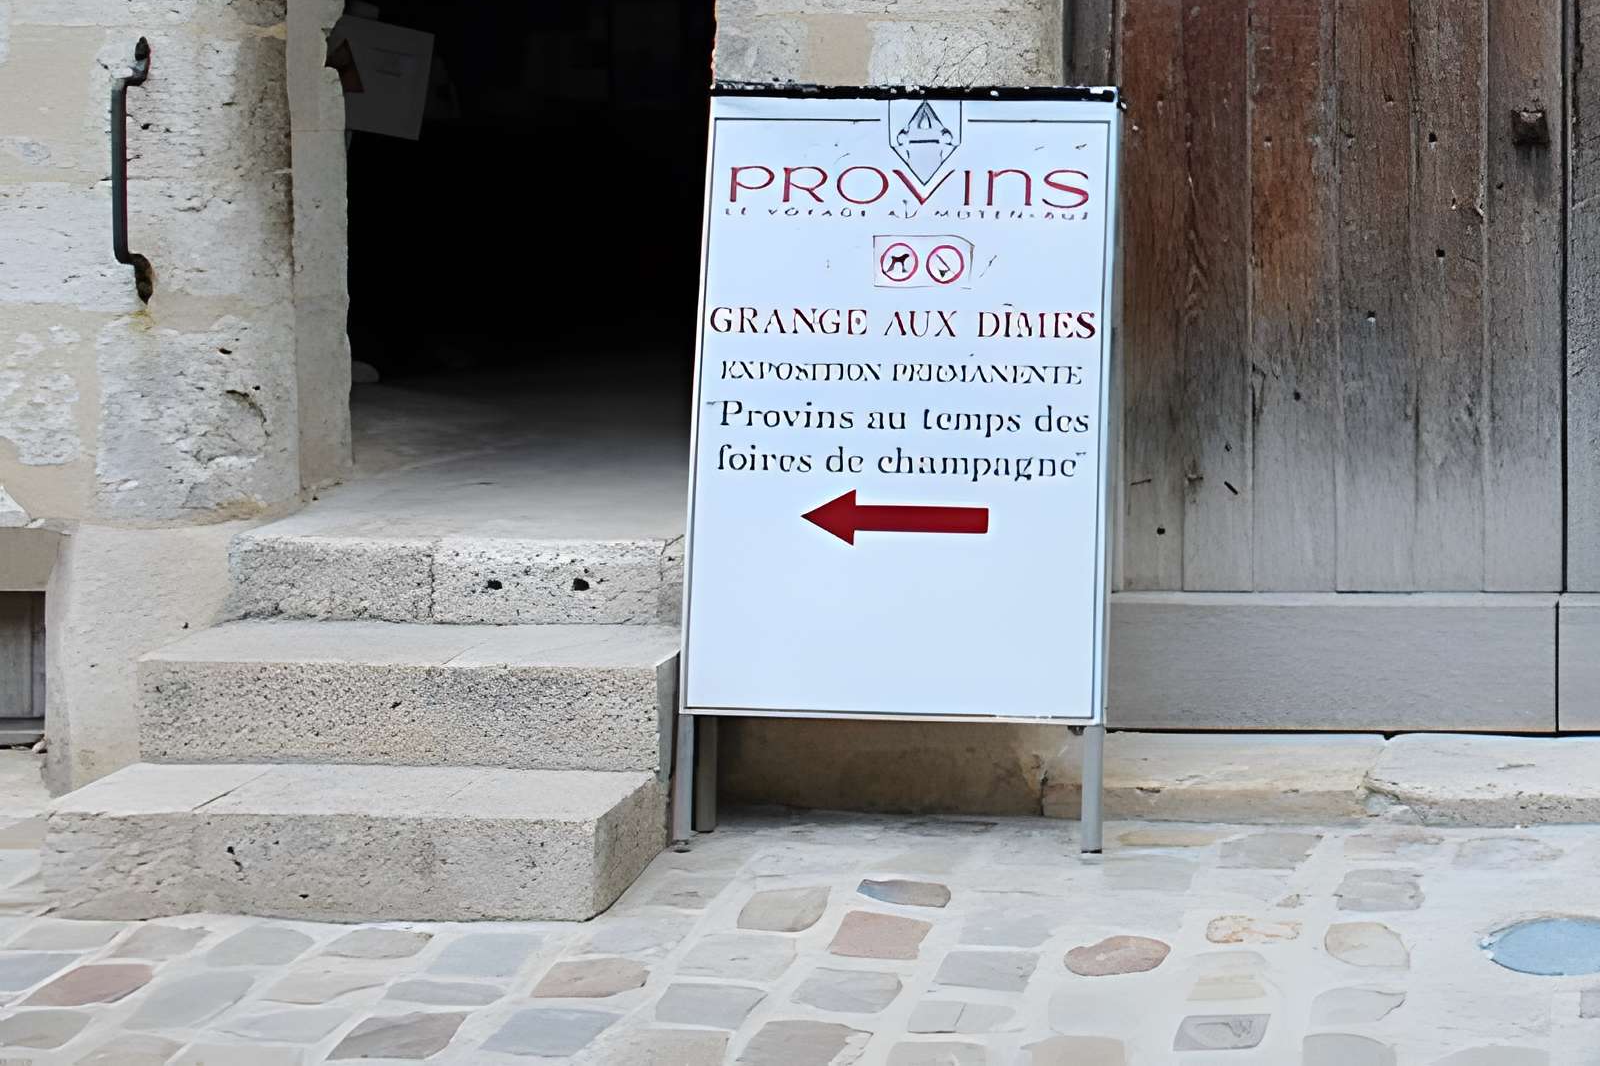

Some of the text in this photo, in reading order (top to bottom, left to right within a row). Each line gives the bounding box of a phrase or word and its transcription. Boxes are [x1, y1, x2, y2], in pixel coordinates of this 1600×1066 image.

[729, 165, 1090, 209] PROVINS
[709, 302, 1097, 339] GRANGE AUX DÎMES
[721, 360, 1083, 385] EXPOSITION PERMANENTE
[867, 410, 906, 430] au
[922, 408, 1022, 438] temps
[1034, 404, 1090, 433] des
[717, 443, 813, 473] foires
[825, 445, 864, 474] de
